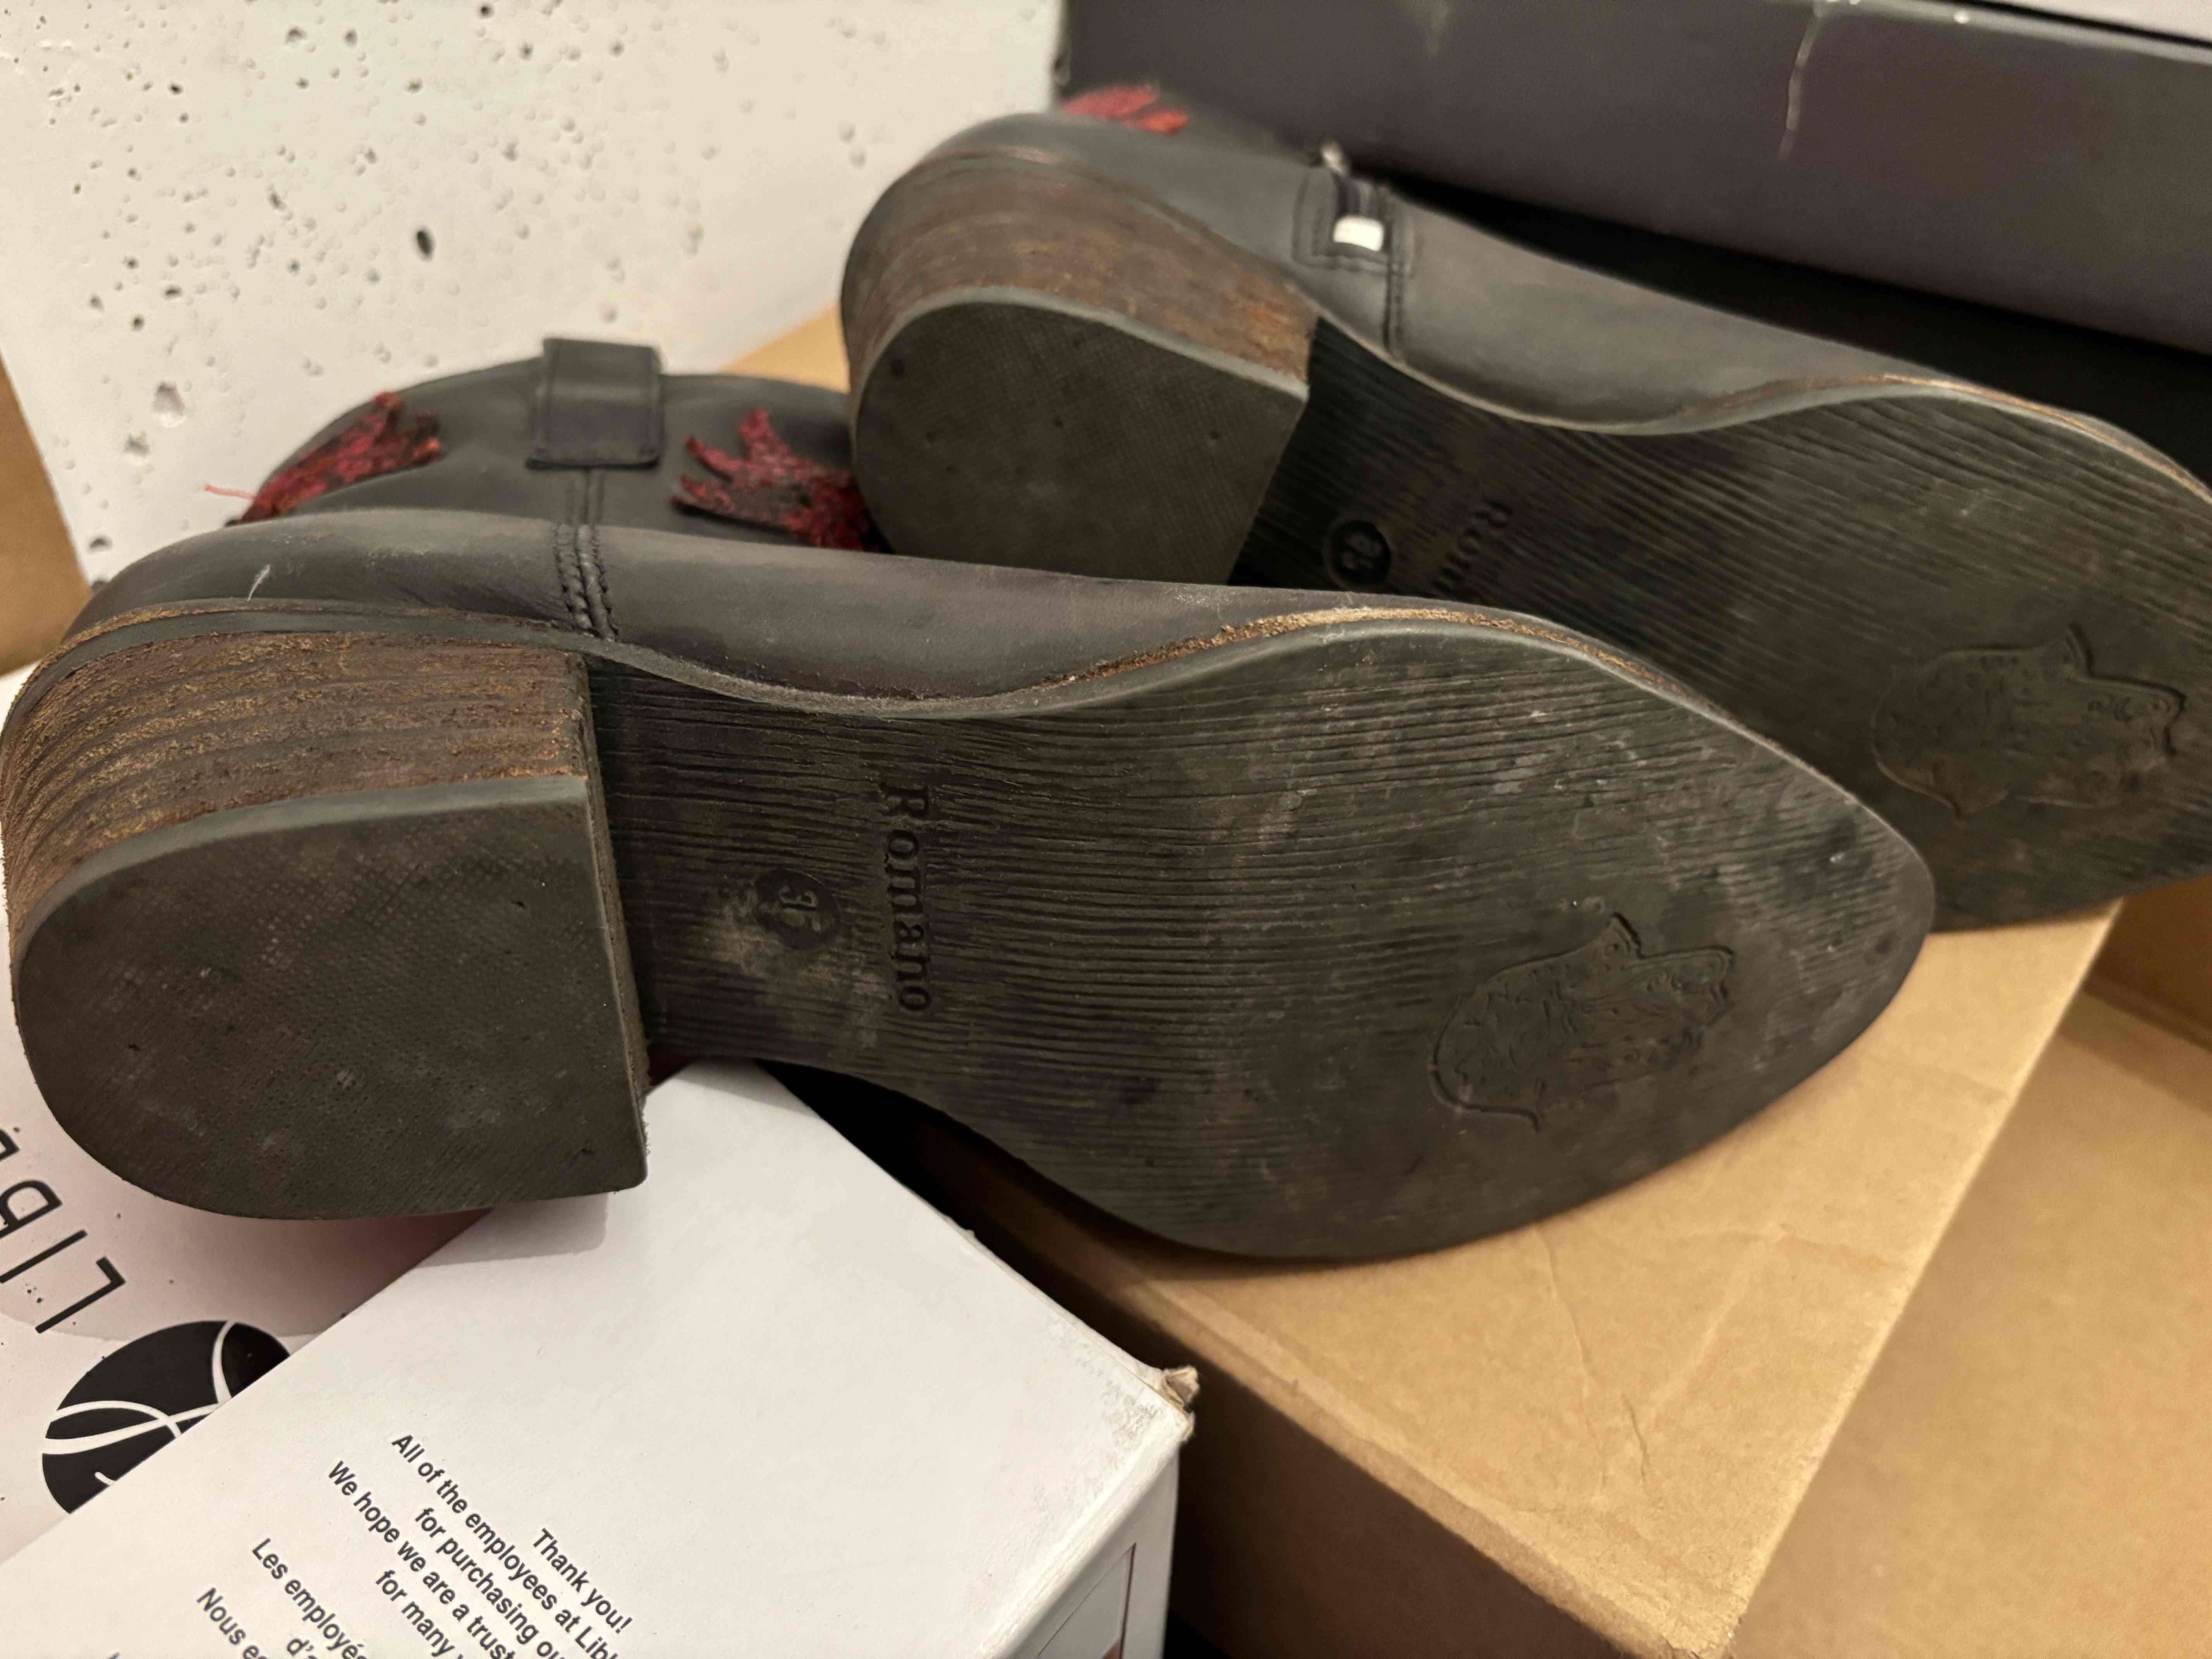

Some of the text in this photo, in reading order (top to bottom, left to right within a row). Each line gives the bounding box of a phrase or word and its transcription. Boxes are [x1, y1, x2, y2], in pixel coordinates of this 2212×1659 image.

[880, 781, 930, 1012] Romano
[0, 1129, 126, 1334] LIB
[252, 1538, 367, 1659] Les employé
[328, 1460, 357, 1495] We
[353, 1491, 400, 1542] hope
[398, 1541, 426, 1571] we
[423, 1571, 455, 1604] are
[452, 1604, 469, 1621] a
[392, 1435, 618, 1659] All of the employees at Lib
[415, 1508, 446, 1538] for
[436, 1538, 539, 1645] purchasing
[533, 1528, 632, 1634] Thank you!
[197, 1588, 246, 1645] Nous
[376, 1570, 455, 1657] for many
